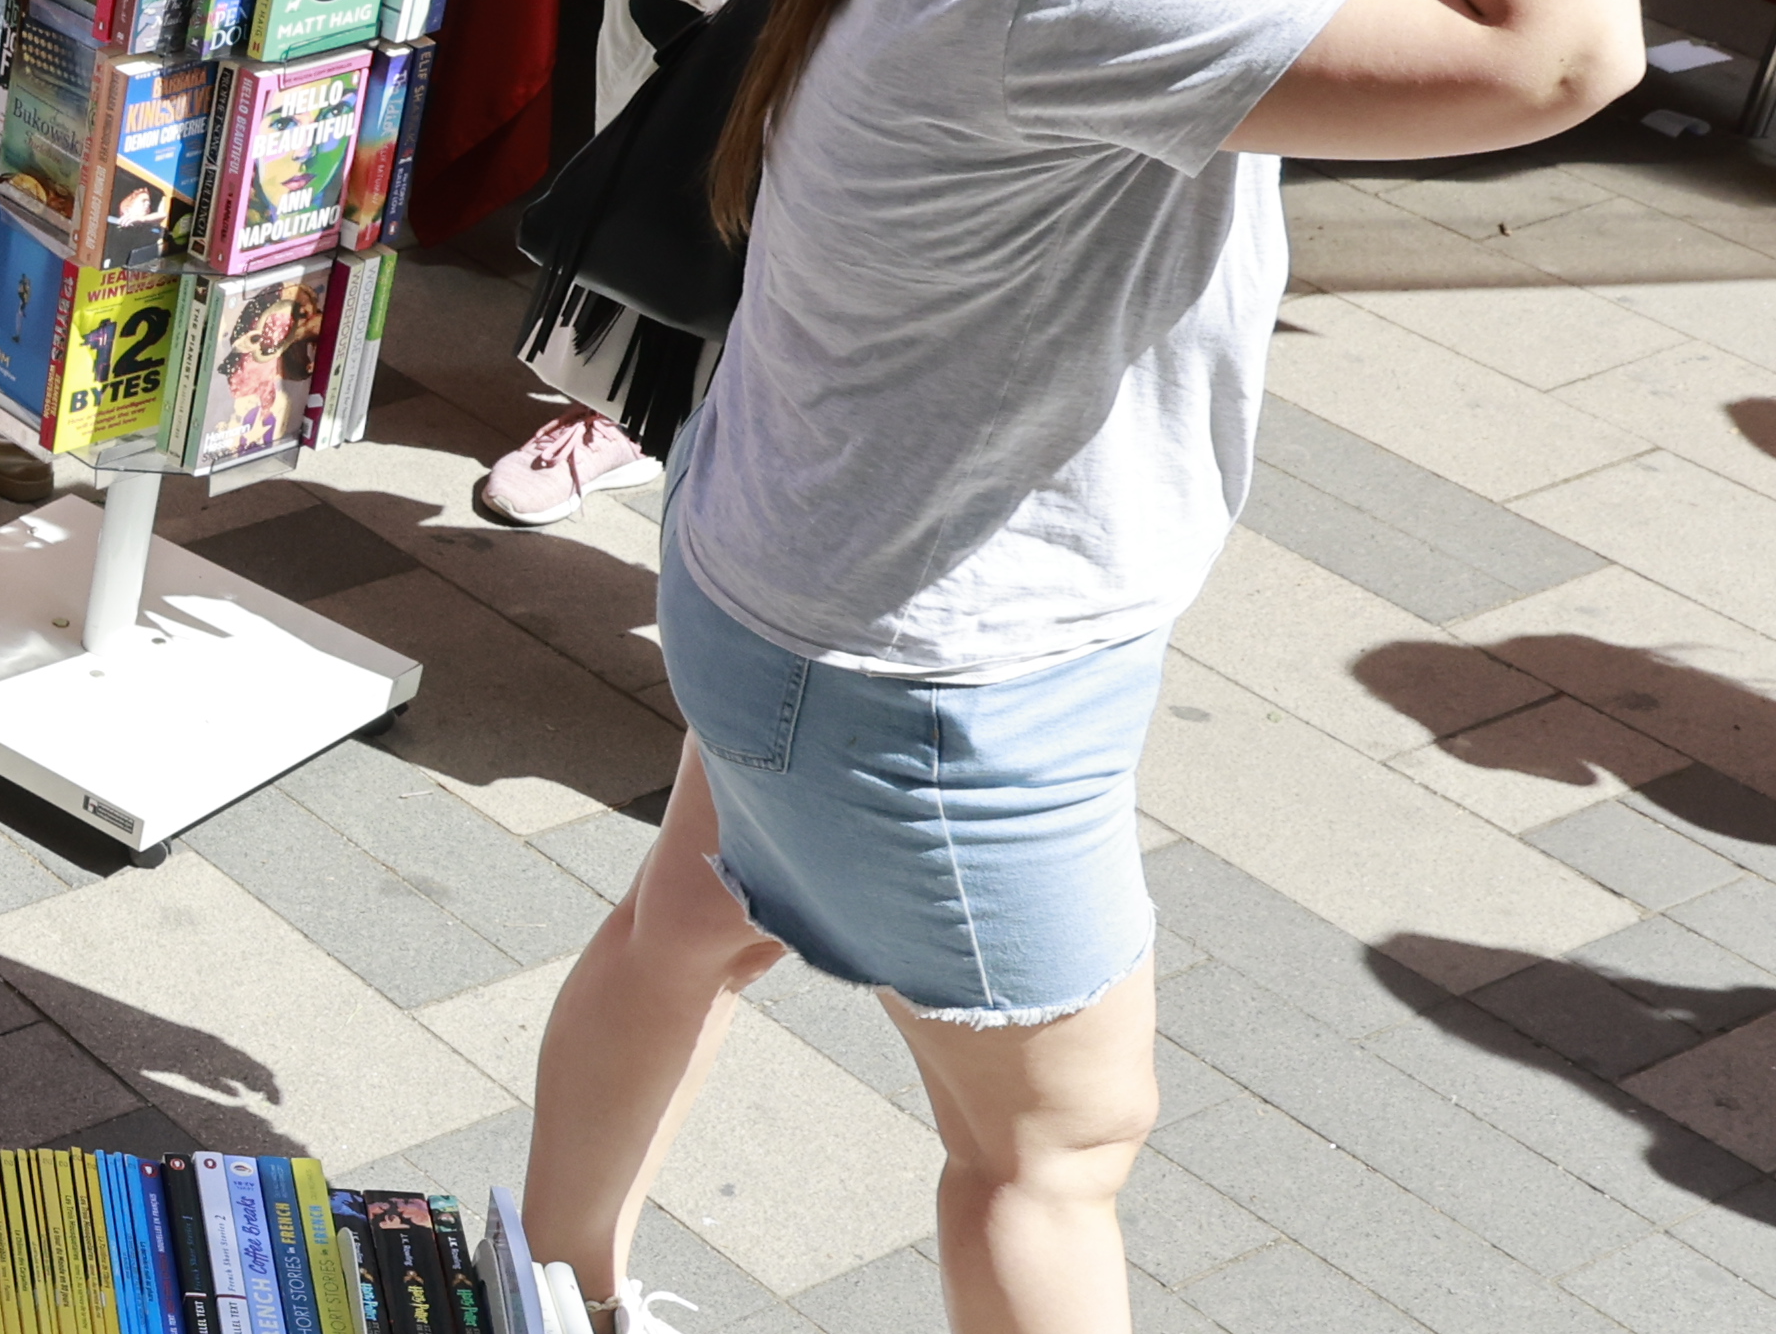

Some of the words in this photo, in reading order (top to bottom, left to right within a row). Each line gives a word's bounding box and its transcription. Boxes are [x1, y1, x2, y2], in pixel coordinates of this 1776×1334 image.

[277, 9, 326, 39] MATT
[328, 4, 372, 29] HAIG
[281, 80, 344, 117] HELLO
[252, 113, 356, 159] BEAUTIFUL
[276, 188, 313, 216] ANN
[237, 204, 341, 250] NAPOLITANO
[82, 305, 173, 384] 12
[68, 373, 162, 414] BYTES
